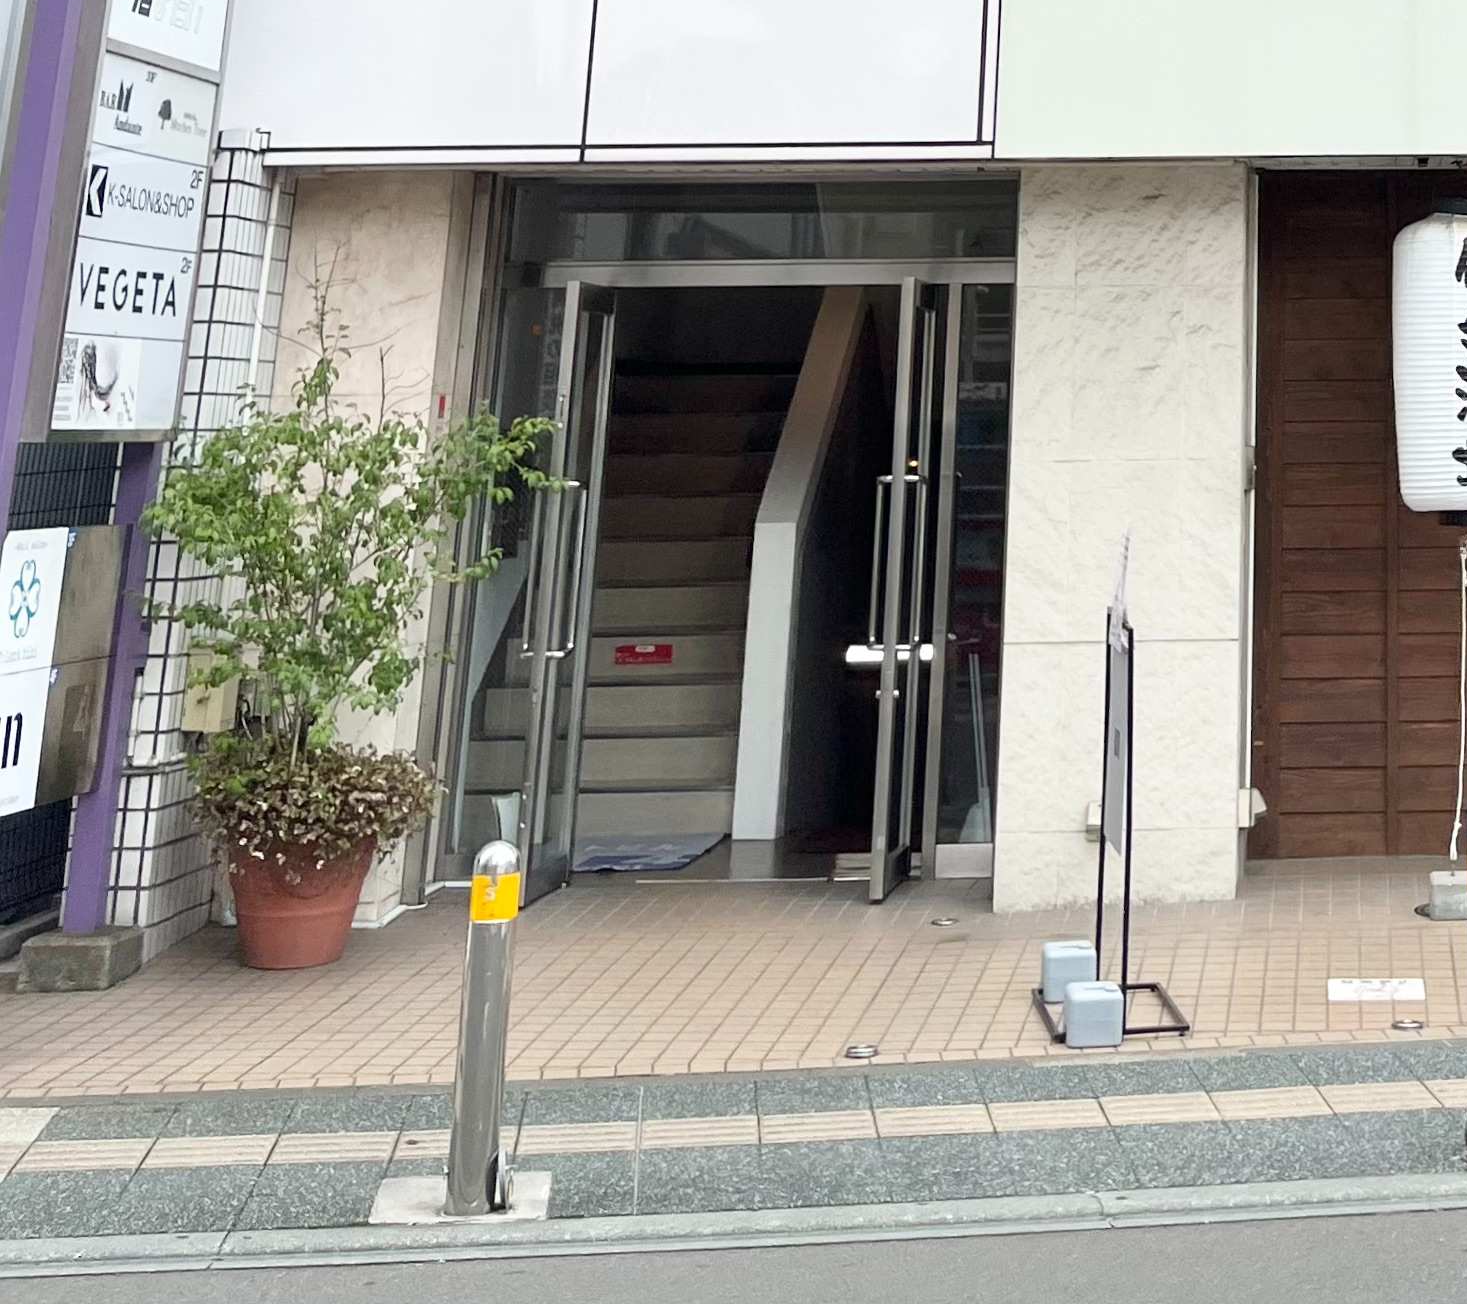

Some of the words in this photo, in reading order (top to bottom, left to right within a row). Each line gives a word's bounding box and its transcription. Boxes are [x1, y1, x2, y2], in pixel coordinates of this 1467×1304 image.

[190, 170, 204, 189] 2F
[107, 183, 194, 218] K-SALON&SHOP
[180, 257, 193, 274] 2F
[80, 262, 177, 318] VEGETA
